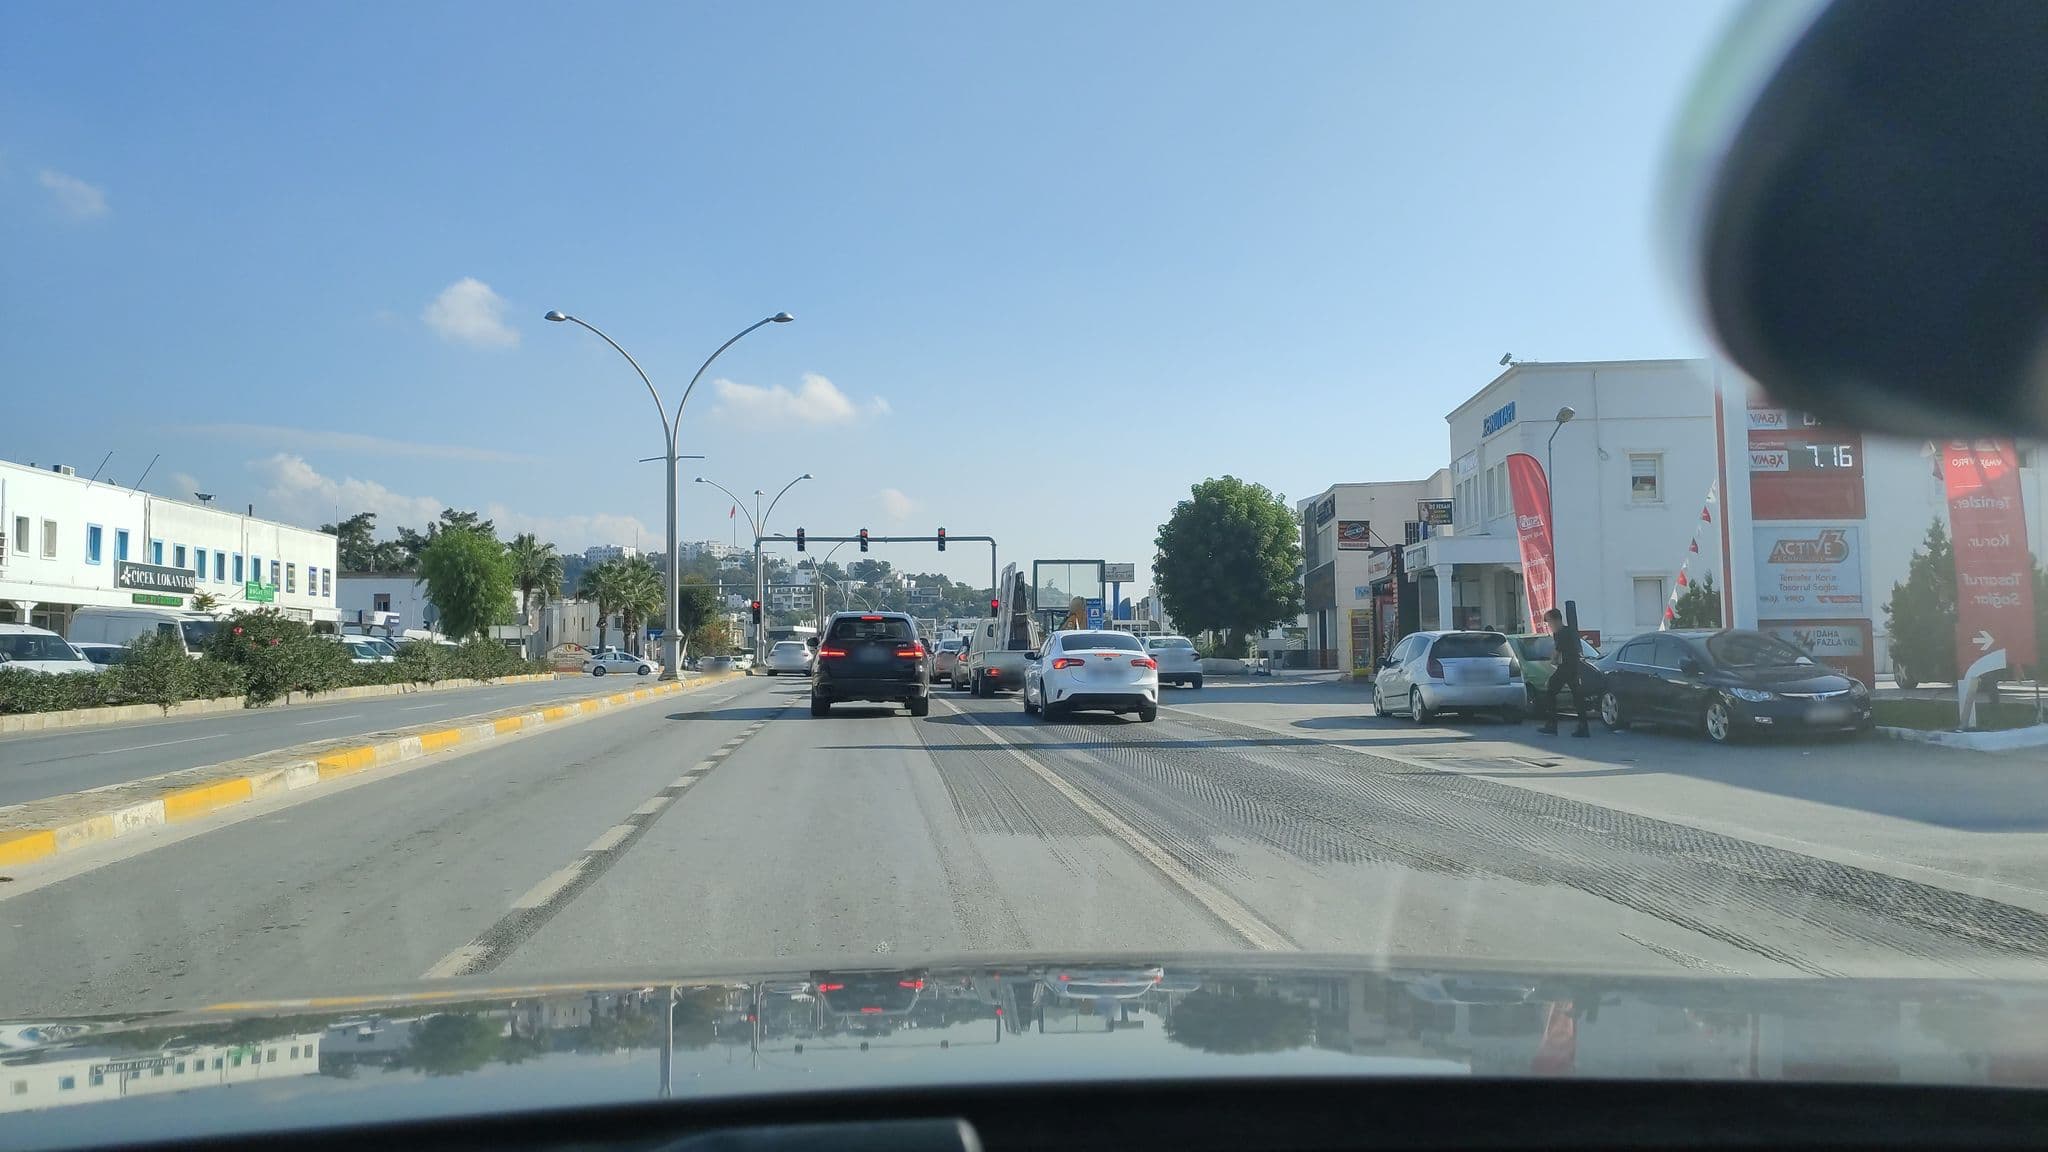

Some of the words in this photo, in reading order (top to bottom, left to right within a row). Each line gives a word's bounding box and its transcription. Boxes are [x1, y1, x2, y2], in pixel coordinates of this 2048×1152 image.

[1805, 445, 1853, 468] 7.16
[1774, 536, 1832, 555] ACTIVE
[131, 567, 156, 586] ÇİÇEK
[157, 573, 195, 588] LOKANTASI
[1816, 630, 1839, 638] DAHA
[1816, 638, 1841, 647] FAZLA
